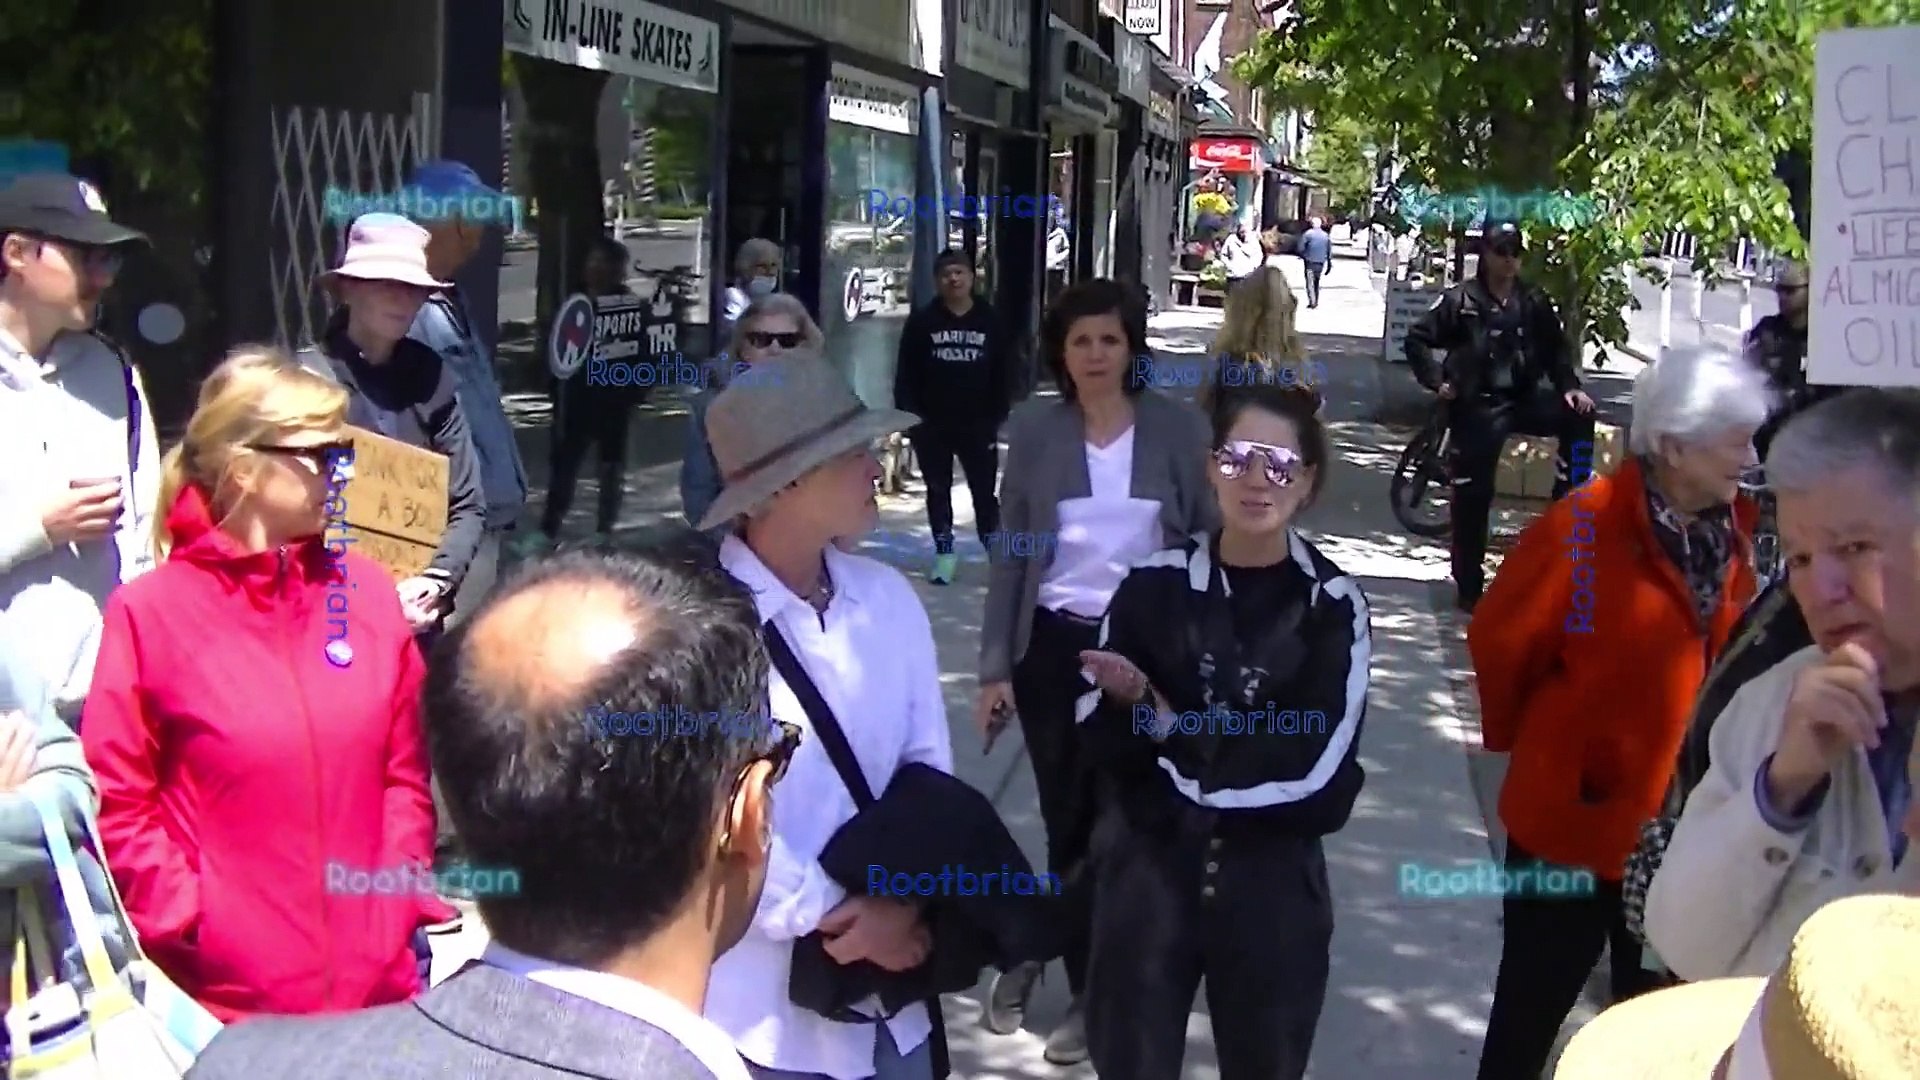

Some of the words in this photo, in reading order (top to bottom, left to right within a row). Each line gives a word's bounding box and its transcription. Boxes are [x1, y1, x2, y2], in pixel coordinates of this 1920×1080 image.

[543, 0, 623, 54] IN-LINE
[630, 17, 692, 71] SKATES
[1129, 17, 1155, 28] NOW
[595, 311, 641, 339] SPORTS
